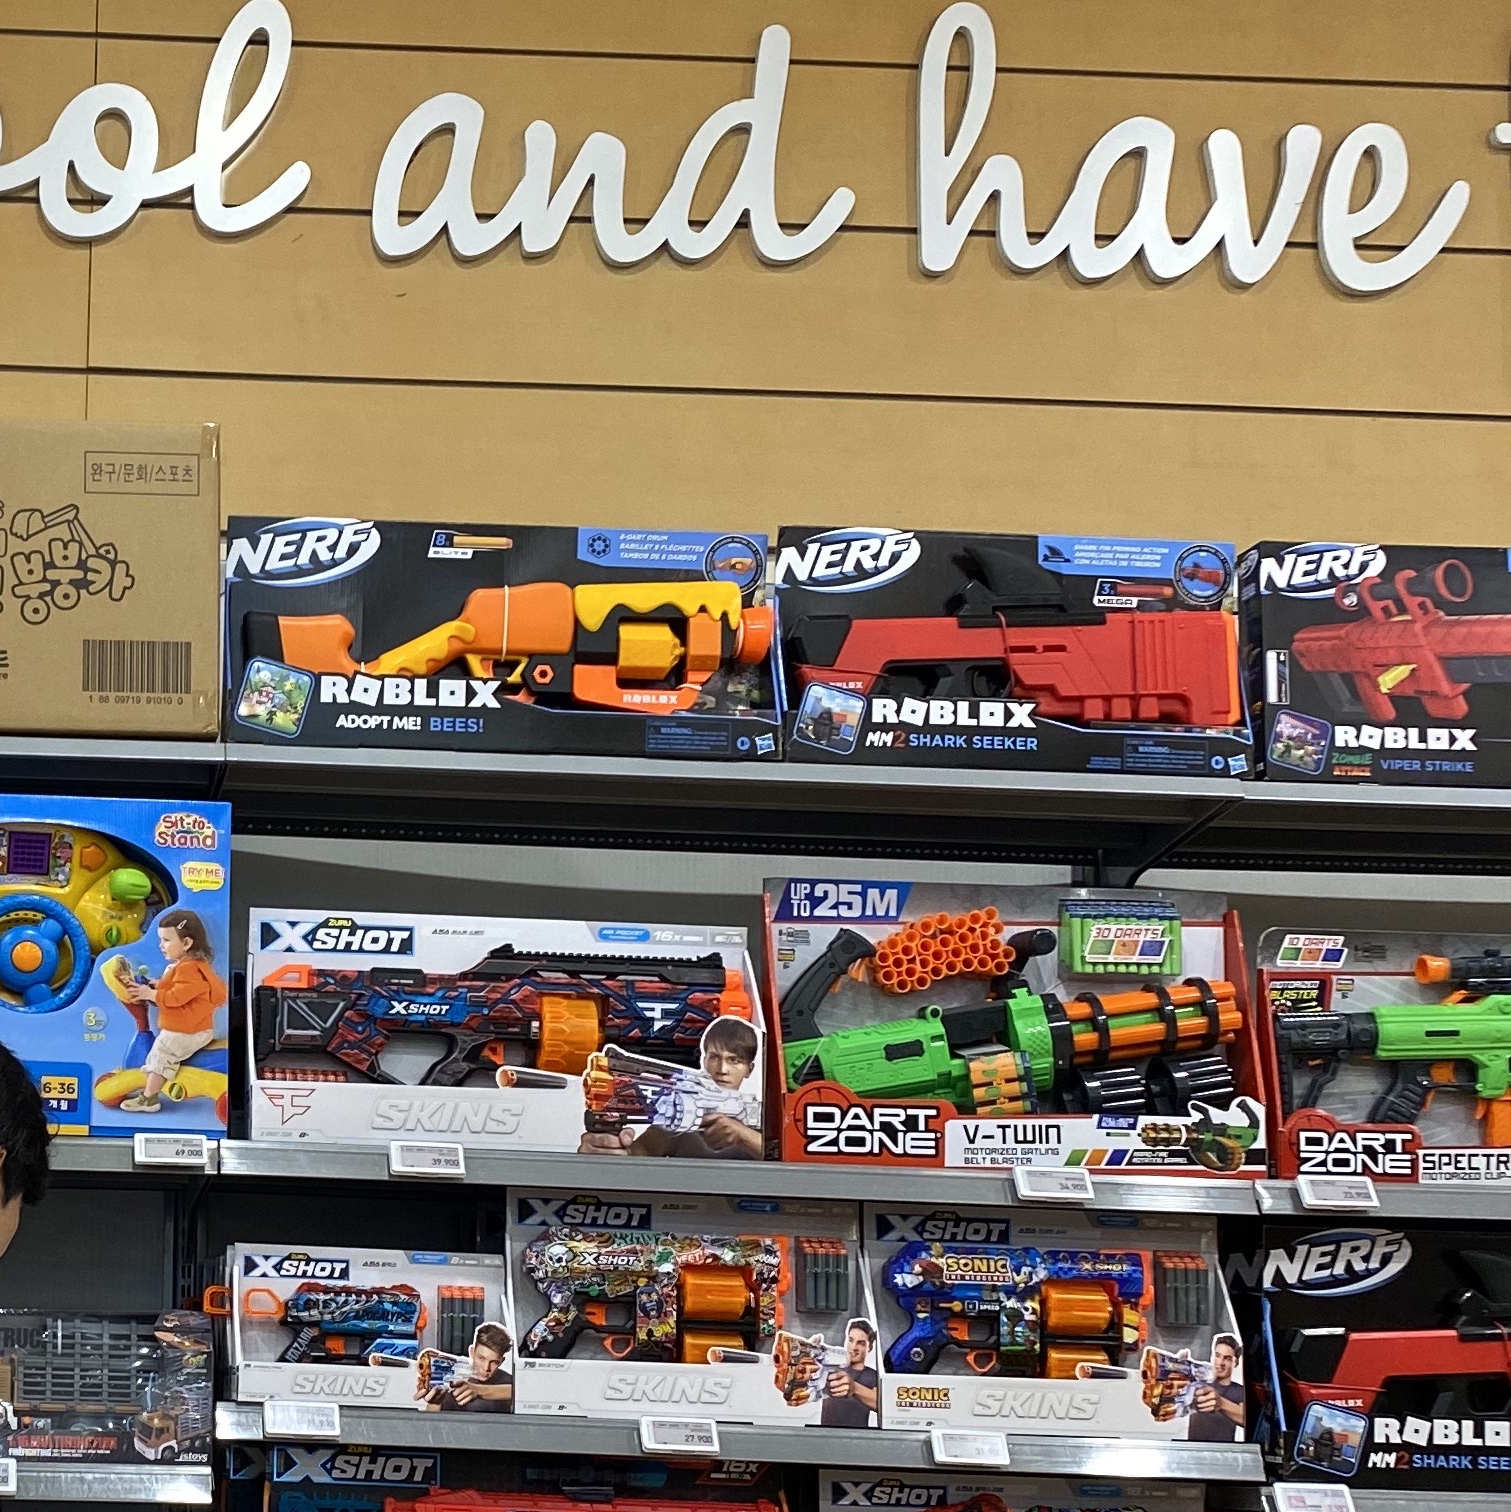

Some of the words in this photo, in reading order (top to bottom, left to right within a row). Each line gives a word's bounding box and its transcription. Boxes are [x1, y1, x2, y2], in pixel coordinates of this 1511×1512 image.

[372, 26, 854, 265] and
[918, 2, 1470, 294] have
[89, 462, 194, 485] 완구/문화/스포츠
[227, 520, 378, 582] NERF
[775, 531, 918, 585] NERF
[1260, 546, 1383, 592] NERF
[10, 537, 135, 625] 붕붕카
[320, 674, 504, 709] ROBLOX
[335, 715, 386, 731] ADOPT
[387, 715, 422, 731] ME!
[429, 716, 484, 733] BEES!
[871, 697, 1037, 728] ROBLOX
[865, 730, 907, 749] MM2
[909, 732, 967, 749] SHARK
[972, 735, 1039, 751] SEEKER
[1334, 724, 1478, 751] ROBLOX
[1380, 759, 1422, 771] VIPER
[1425, 759, 1475, 772] STRIKE
[157, 829, 219, 850] Stand
[790, 883, 811, 899] UP
[790, 900, 811, 918] TO
[814, 883, 898, 918] 25M
[1093, 927, 1113, 938] 30
[1118, 928, 1161, 940] DARTS
[1303, 937, 1341, 948] DARTS
[41, 1081, 76, 1095] 6-36
[371, 1099, 525, 1135] SKINS
[806, 1106, 938, 1132] DART
[806, 1131, 938, 1155] ZONE
[963, 1124, 1062, 1145] V-TWIN
[1299, 1131, 1413, 1152] DART
[964, 1157, 988, 1165] BELT
[990, 1157, 1032, 1165] BLASTER
[1299, 1152, 1412, 1175] ZONE
[944, 1256, 1008, 1275] SONIC
[1263, 1231, 1406, 1289] NERF
[292, 1374, 388, 1397] SKINS
[603, 1373, 733, 1404] SKINS
[896, 1386, 951, 1402] SONIC
[971, 1388, 1100, 1420] SKINS
[1412, 1454, 1472, 1470] SHARK
